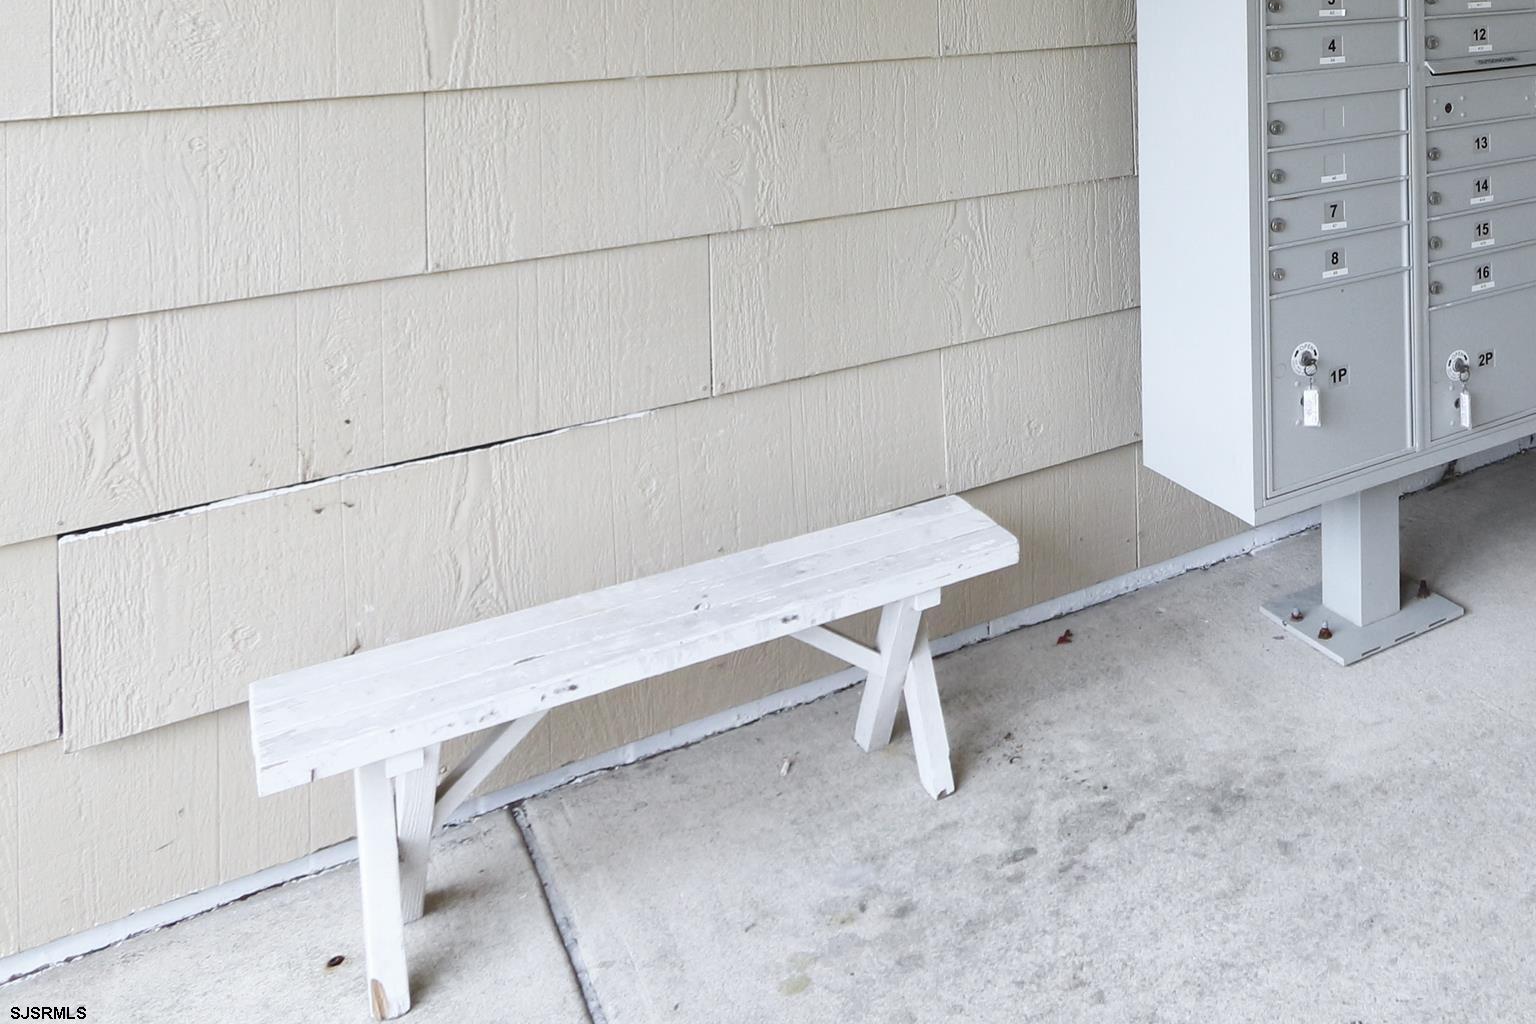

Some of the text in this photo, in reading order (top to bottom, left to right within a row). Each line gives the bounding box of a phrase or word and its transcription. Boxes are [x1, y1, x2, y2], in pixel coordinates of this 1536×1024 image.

[1473, 28, 1487, 41] 12
[1327, 39, 1337, 53] 4
[1474, 136, 1488, 150] 13
[1475, 179, 1489, 193] 14
[1329, 204, 1338, 218] 7
[1476, 222, 1490, 237] 15
[1331, 251, 1339, 265] 8
[1476, 265, 1490, 280] 16
[1478, 351, 1494, 367] 2P
[1330, 367, 1347, 384] 1P
